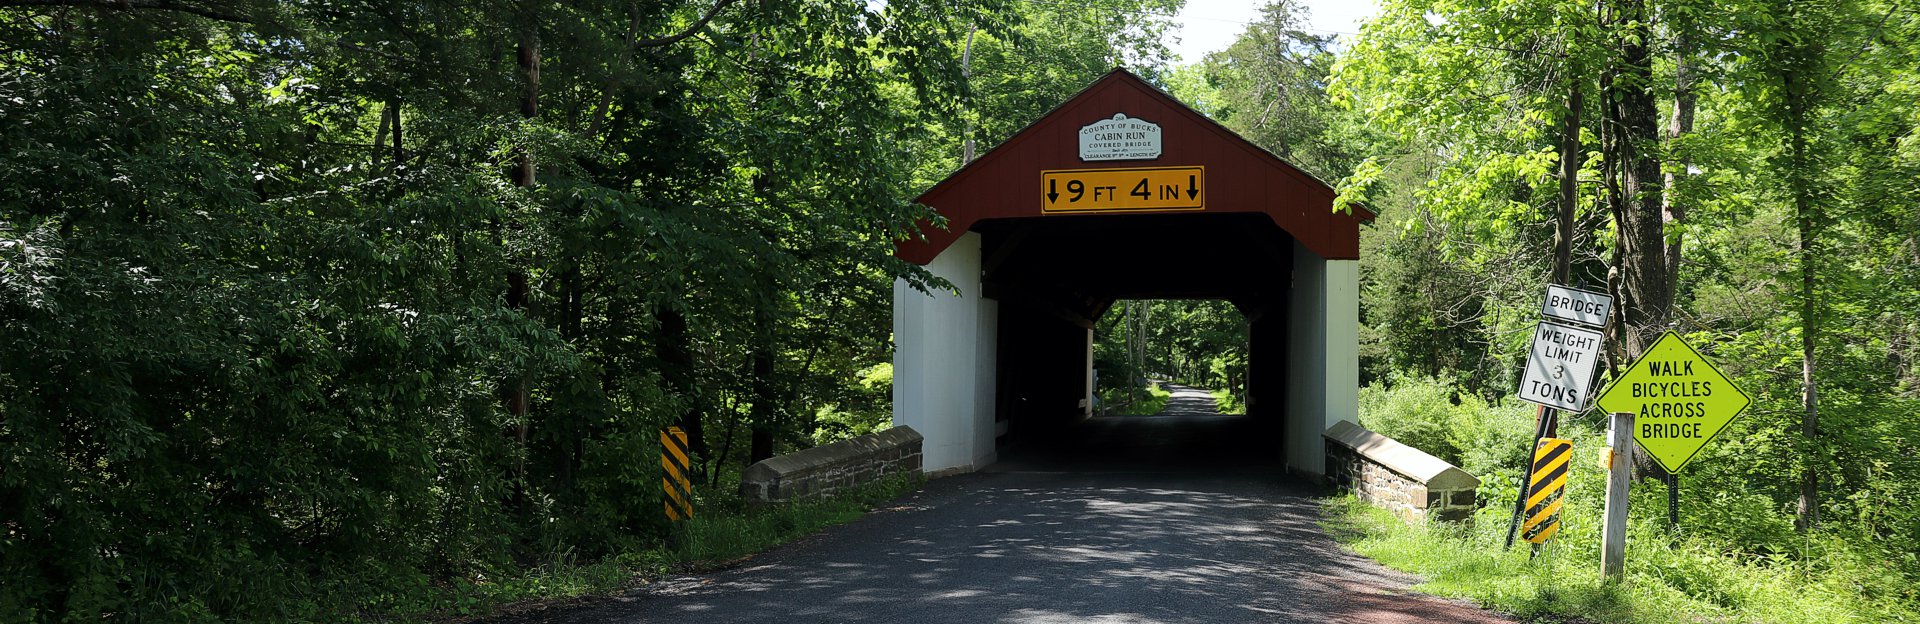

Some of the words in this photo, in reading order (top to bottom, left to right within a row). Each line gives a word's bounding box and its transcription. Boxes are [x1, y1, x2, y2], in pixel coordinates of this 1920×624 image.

[1083, 124, 1116, 134] COUNTY
[1130, 124, 1157, 133] BUCKS
[1094, 133, 1123, 141] CABIN
[1126, 132, 1146, 140] RUN
[1066, 179, 1085, 203] 9
[1094, 186, 1117, 202] FT
[1130, 178, 1151, 200] 4
[1159, 184, 1179, 200] IN
[1550, 295, 1604, 316] BRIDGE
[1541, 329, 1595, 350] WEIGHT
[1545, 346, 1583, 364] LIMIT
[1552, 365, 1565, 380] 3
[1649, 360, 1694, 377] WALK
[1532, 380, 1577, 404] TONS
[1632, 381, 1712, 398] BICYCLES
[1640, 402, 1705, 418] ACROSS
[1642, 423, 1703, 438] BRIDGE
